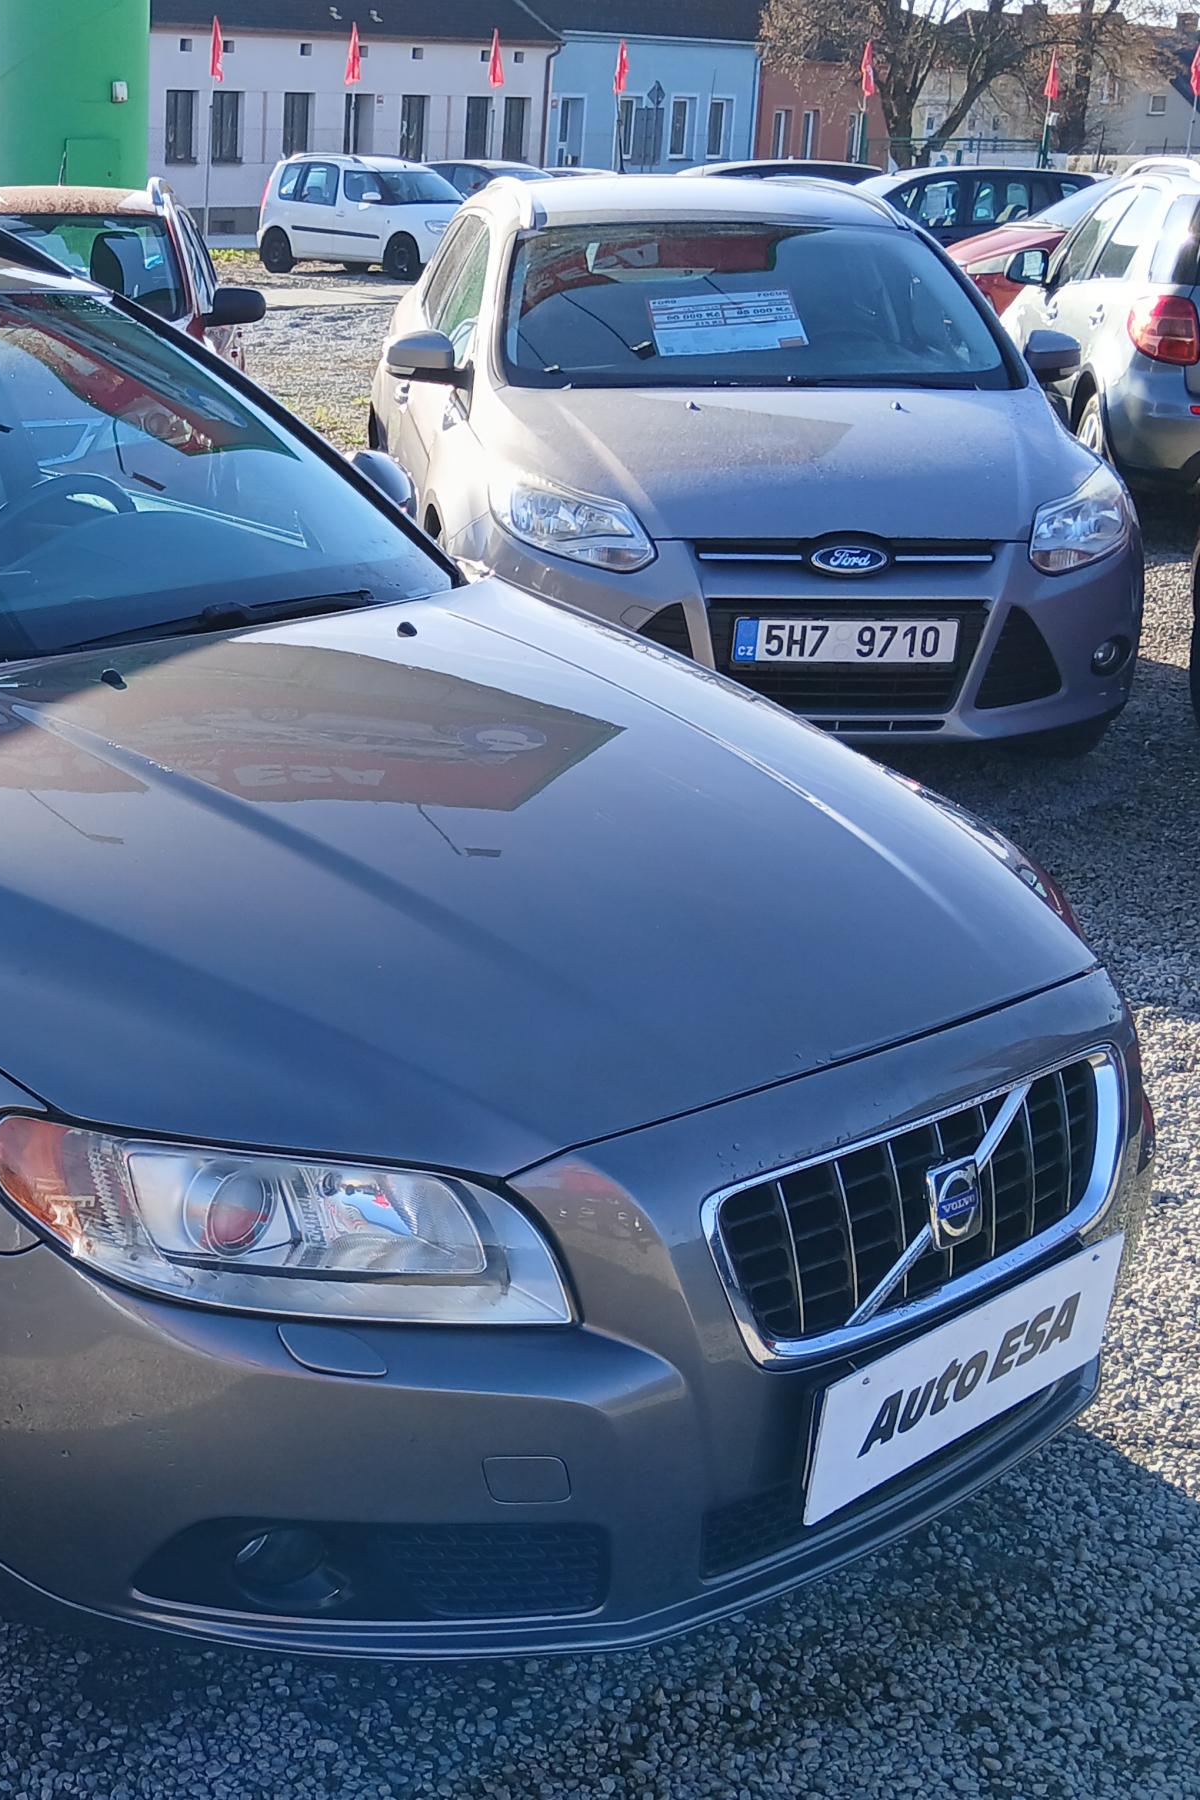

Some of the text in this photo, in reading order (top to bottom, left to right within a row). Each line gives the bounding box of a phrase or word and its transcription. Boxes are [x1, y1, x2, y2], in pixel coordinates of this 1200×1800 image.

[829, 549, 871, 567] Ford
[765, 624, 941, 658] 5H7 9710
[737, 646, 754, 656] CZ
[941, 1194, 976, 1213] VOLVO
[856, 1291, 1082, 1459] Auto ESA
